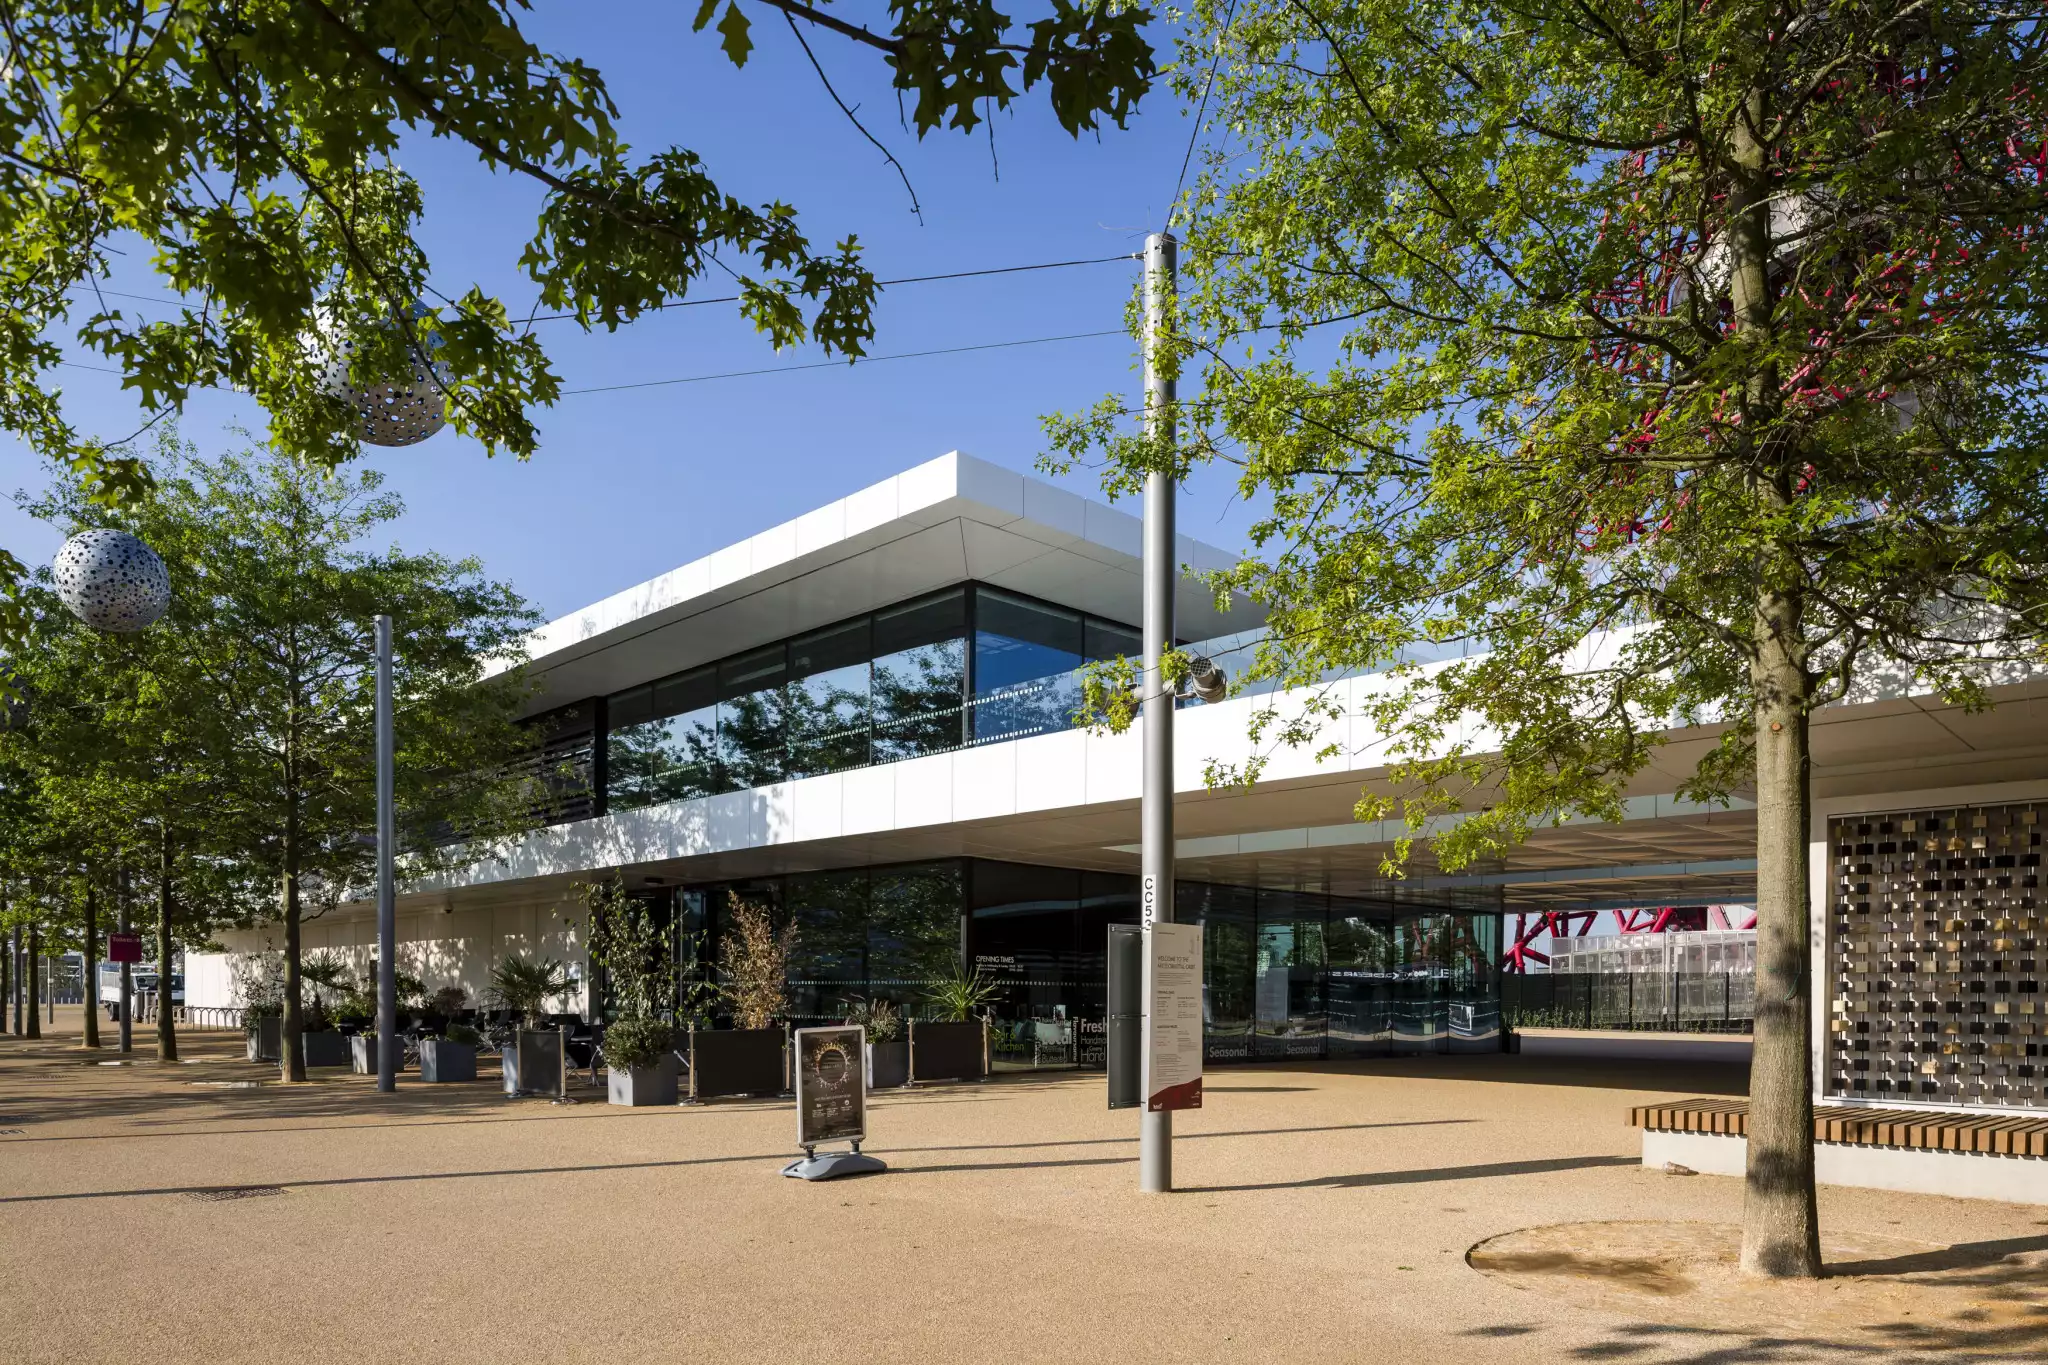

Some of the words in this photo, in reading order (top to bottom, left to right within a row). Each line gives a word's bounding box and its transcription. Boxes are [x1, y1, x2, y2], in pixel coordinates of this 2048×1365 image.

[976, 955, 1000, 963] OPENING
[1000, 956, 1014, 964] TIMES
[996, 1041, 1024, 1051] Kitchen
[1209, 1045, 1248, 1058] Seasonal
[1286, 1042, 1321, 1054] Seasonal
[1081, 1046, 1106, 1063] Hand
